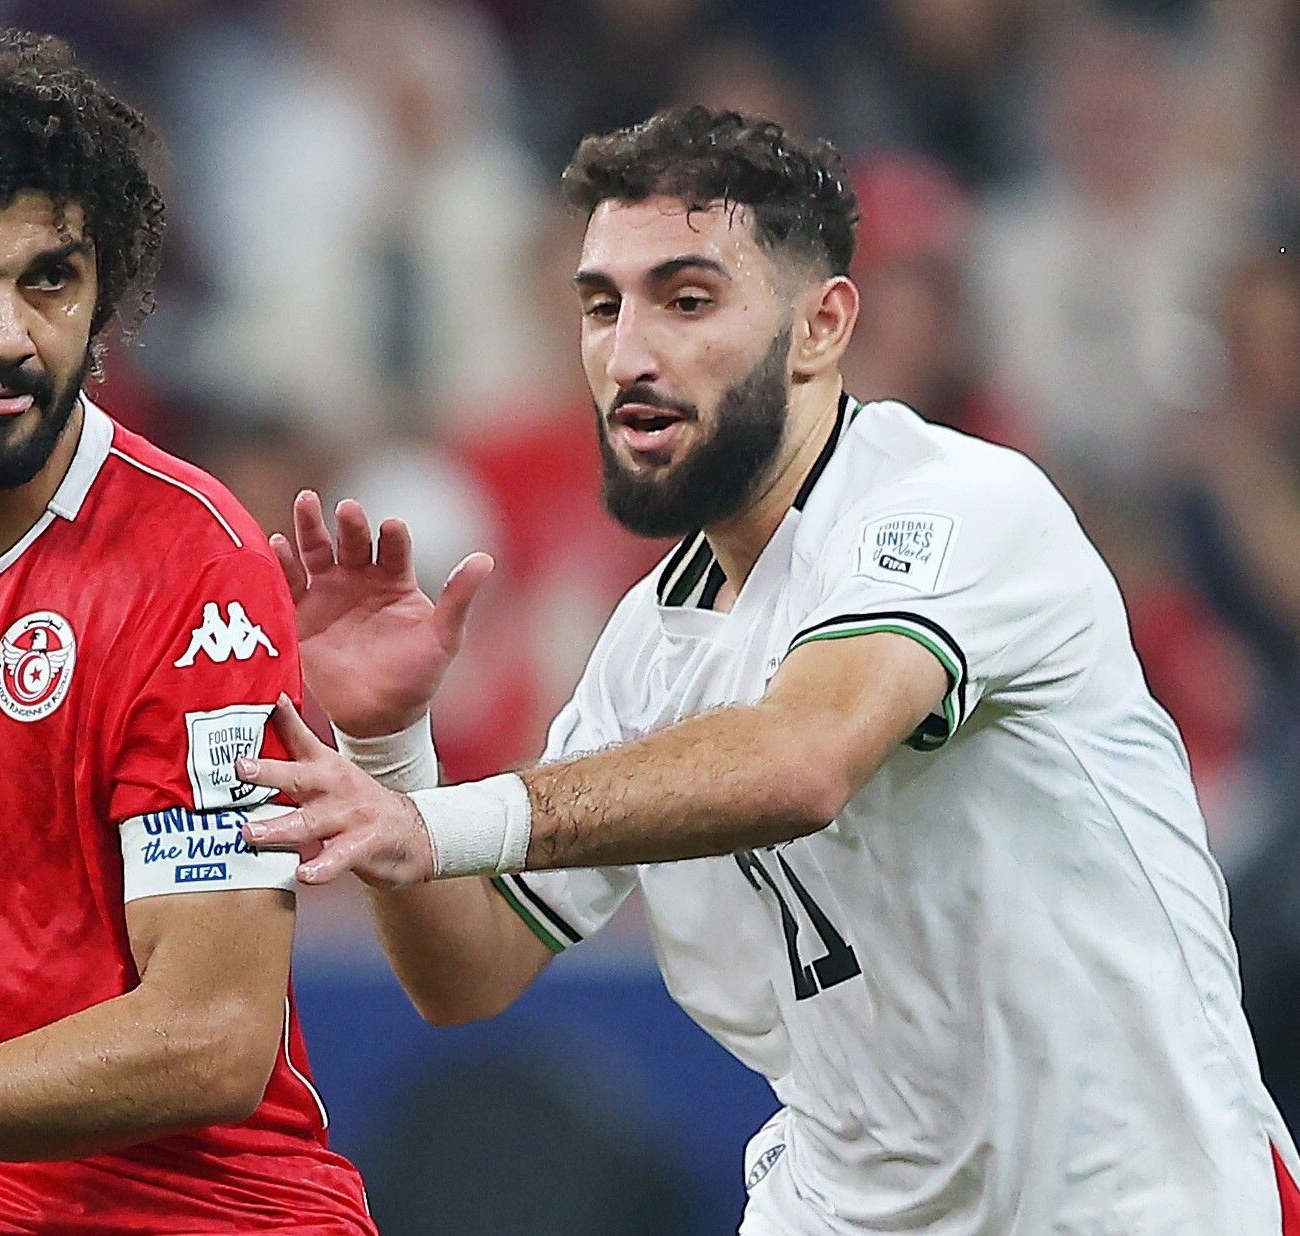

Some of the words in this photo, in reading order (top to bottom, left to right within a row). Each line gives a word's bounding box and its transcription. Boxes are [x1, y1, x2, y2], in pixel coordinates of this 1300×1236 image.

[880, 520, 934, 532] FOOTBALL
[877, 530, 933, 548] UNITES
[881, 555, 909, 572] FIFA
[208, 726, 254, 746] FOOTALL
[208, 767, 232, 786] the
[141, 838, 183, 864] the
[179, 866, 224, 880] FIFA
